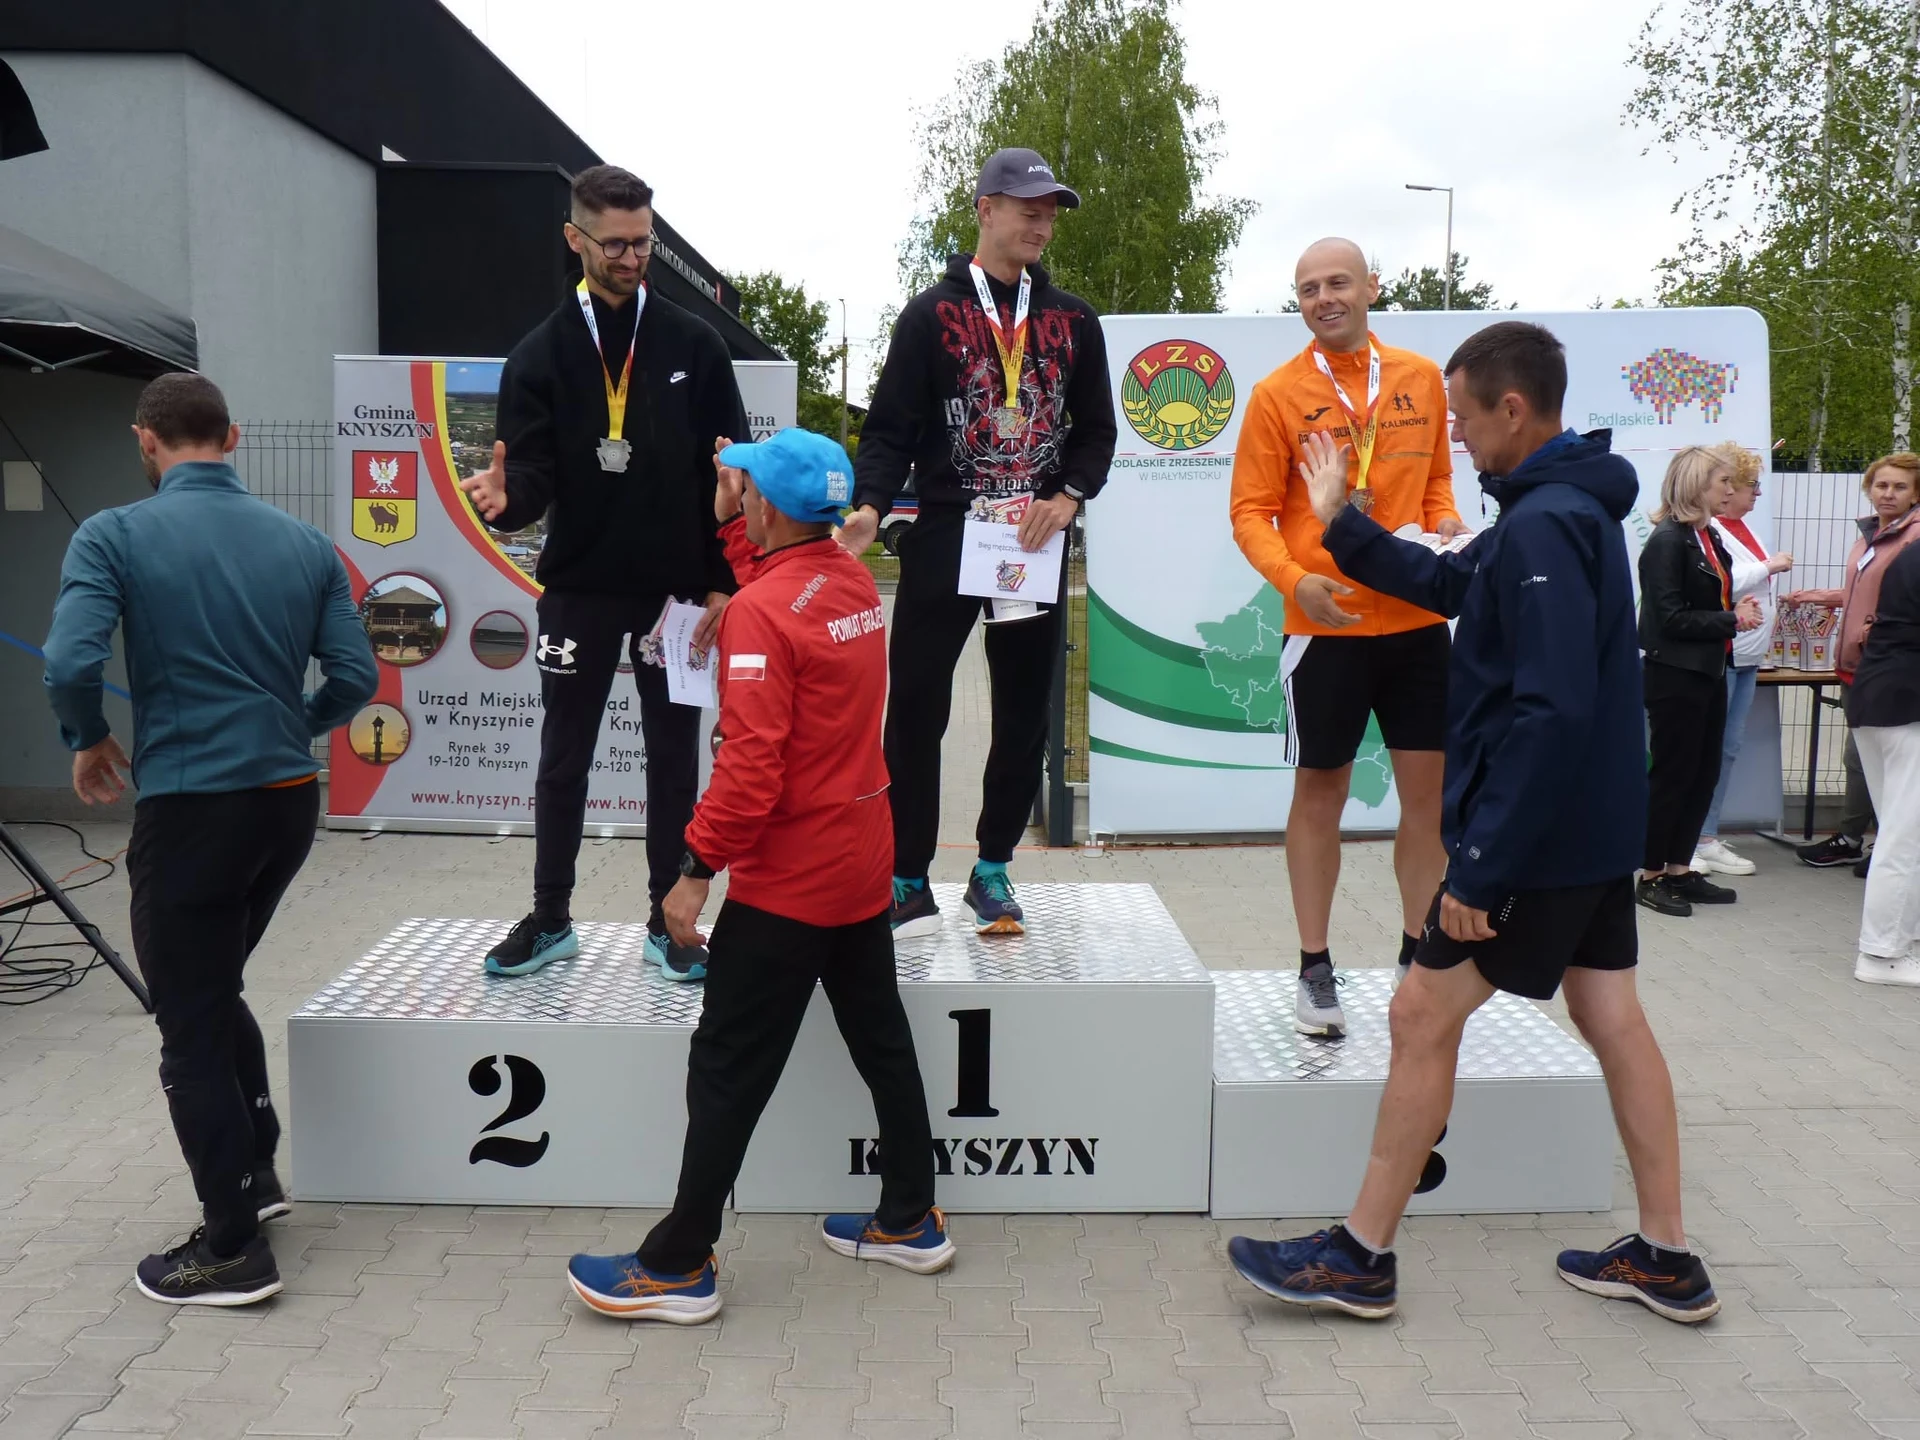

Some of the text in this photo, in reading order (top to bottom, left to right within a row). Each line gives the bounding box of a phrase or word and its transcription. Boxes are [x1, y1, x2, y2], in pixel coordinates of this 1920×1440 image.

[1136, 345, 1217, 378] LZS
[354, 404, 416, 420] Gmina
[1588, 412, 1655, 427] Podlaskie
[337, 422, 433, 438] KNYSZYN
[1168, 457, 1232, 468] ZRZESZENIE
[1139, 470, 1222, 481] W BIAŁYMSTOKU
[789, 573, 828, 614] newline
[826, 605, 884, 644] POWIAT GRAJE
[418, 690, 541, 711] Urząd Miejski
[425, 711, 535, 731] w Knyszynie
[448, 741, 511, 756] Rynek 39
[609, 746, 647, 761] Rynek
[428, 755, 528, 772] 19-120 Knyszyn
[411, 789, 536, 811] www.knyszyn.p
[947, 1008, 1000, 1118] 1
[468, 1054, 550, 1168] 2
[848, 1137, 1100, 1176] KYSZYN
